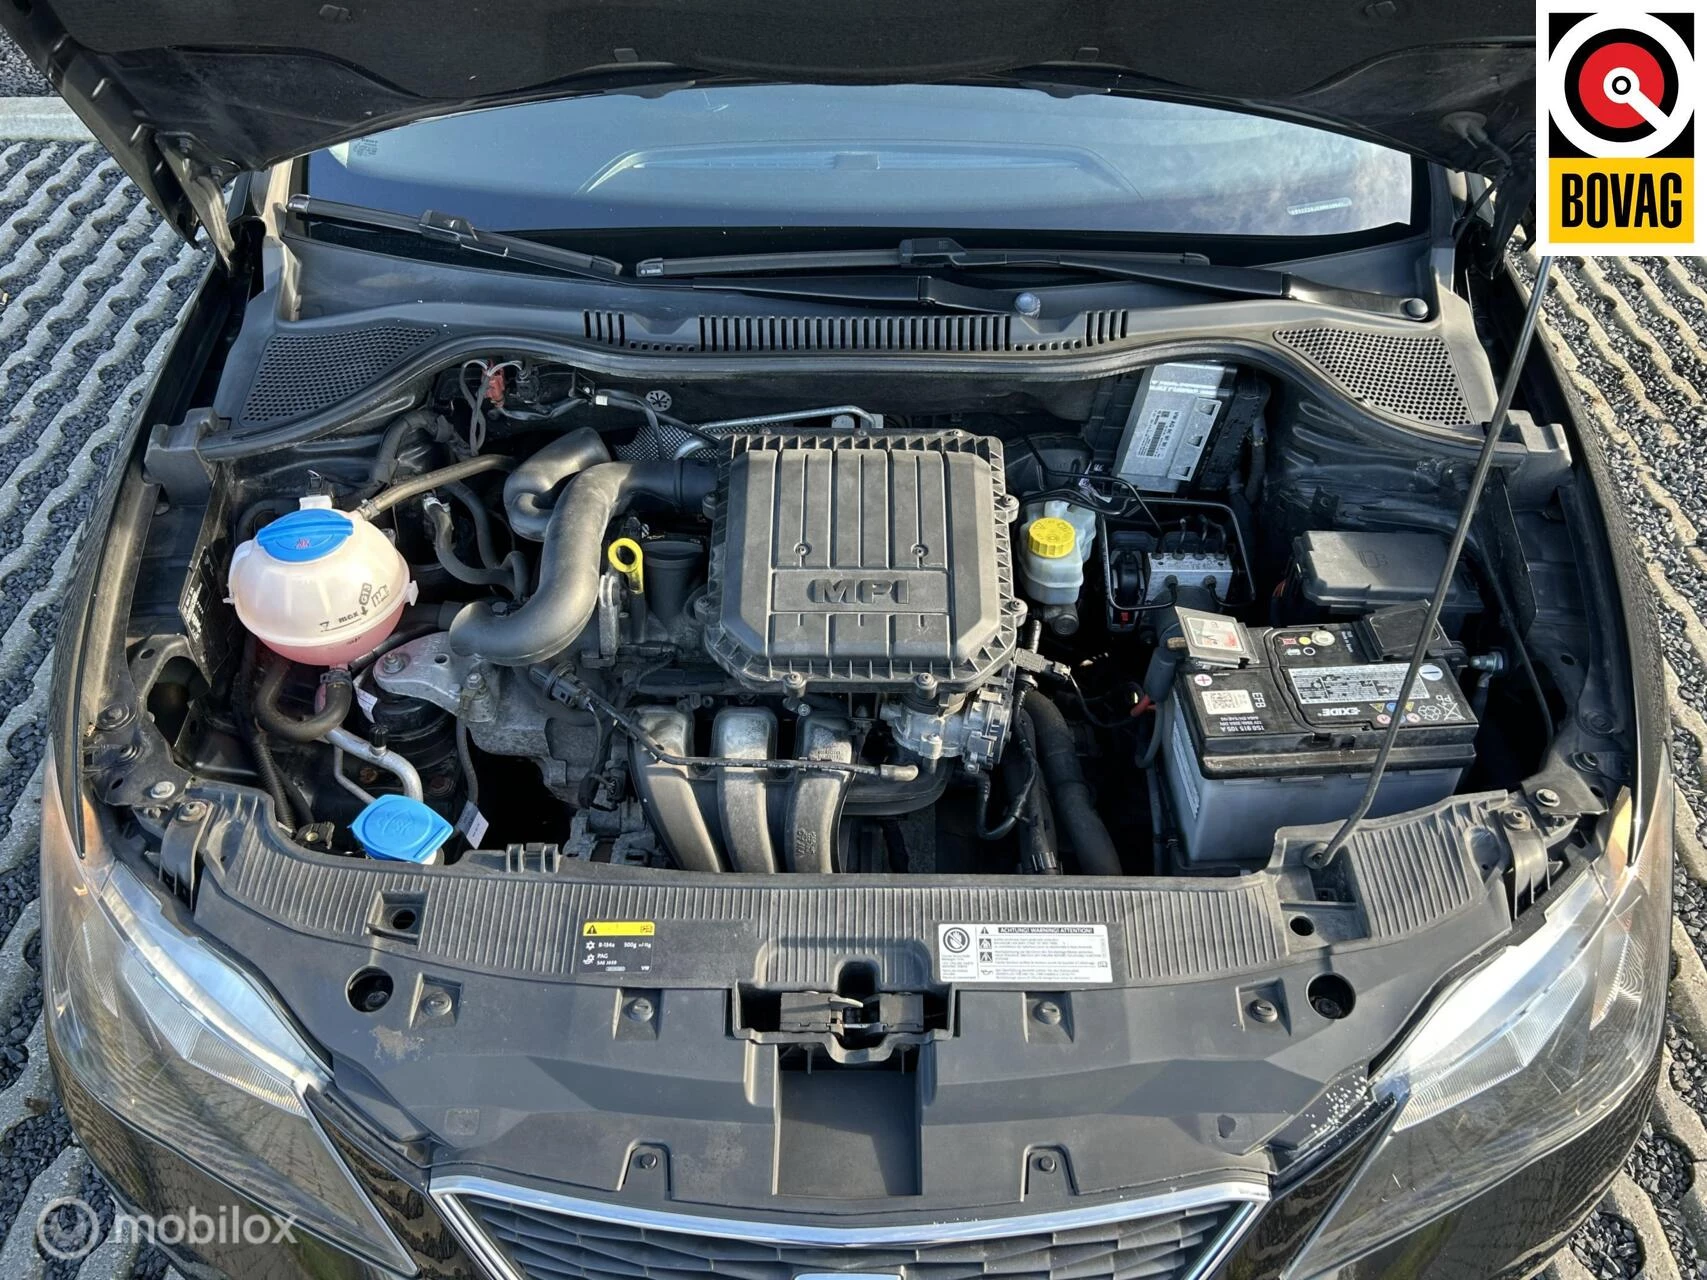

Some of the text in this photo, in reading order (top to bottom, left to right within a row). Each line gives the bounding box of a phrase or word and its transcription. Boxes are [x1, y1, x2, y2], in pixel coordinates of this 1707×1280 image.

[807, 579, 909, 604] MPI
[338, 611, 359, 623] max
[1252, 692, 1266, 708] EFB
[1321, 706, 1360, 717] EXIDE
